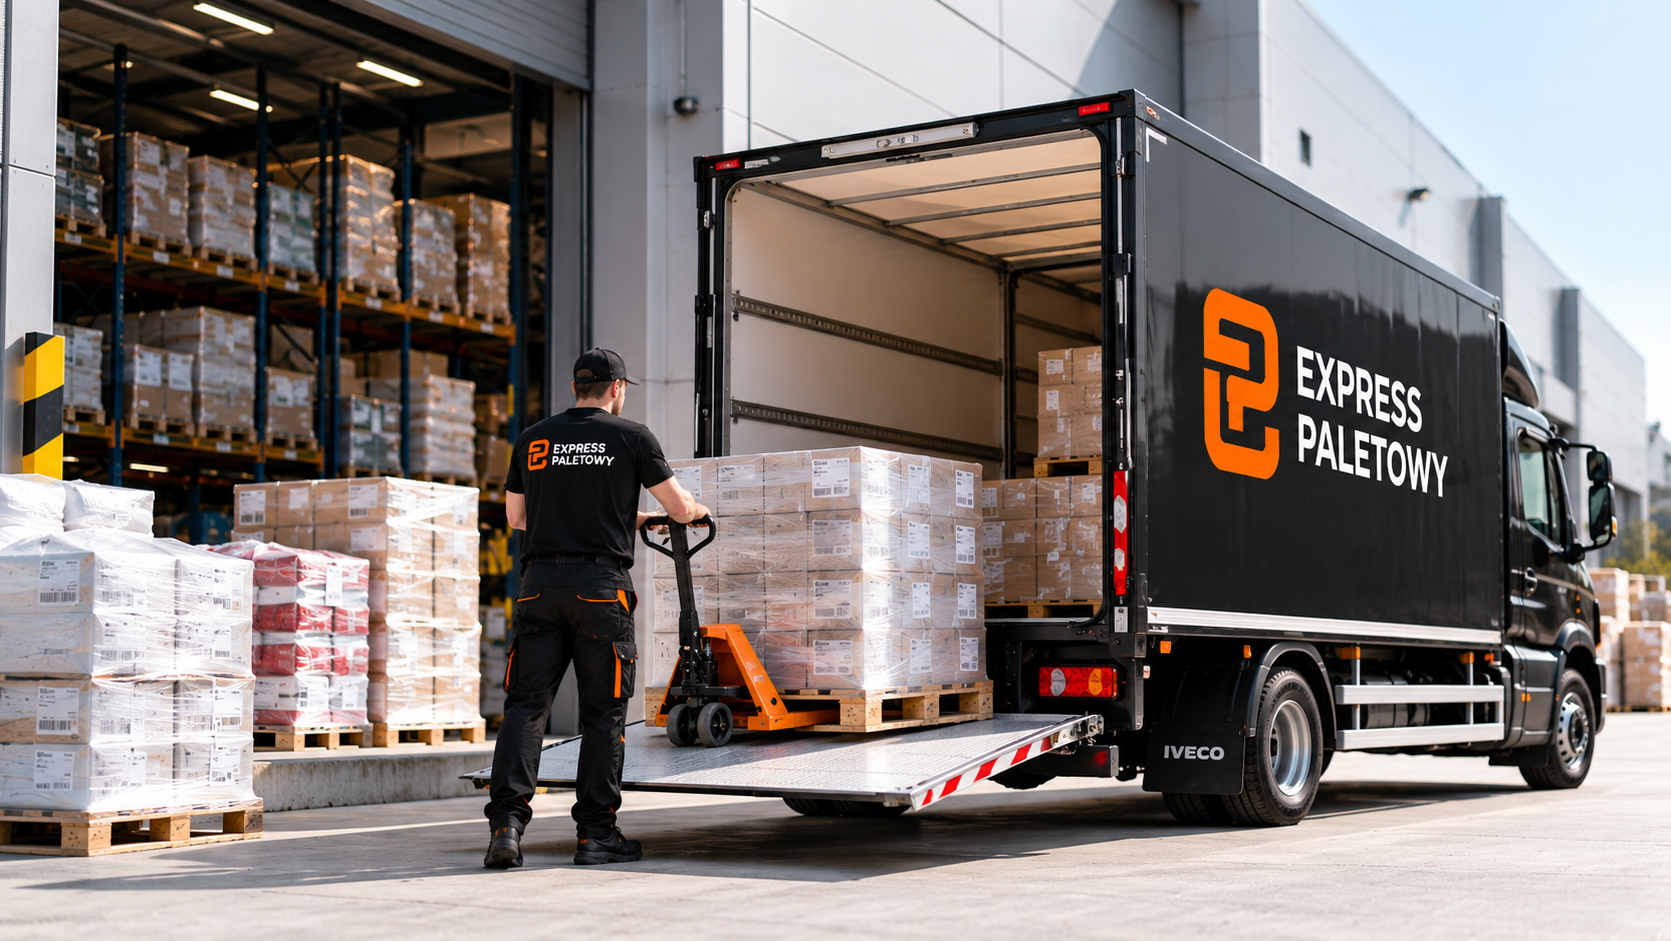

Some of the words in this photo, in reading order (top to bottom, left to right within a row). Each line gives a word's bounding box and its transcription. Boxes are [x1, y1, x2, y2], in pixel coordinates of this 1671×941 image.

[1296, 345, 1423, 433] EXPRESS
[553, 442, 606, 455] EXPRESS
[1297, 413, 1449, 498] PALETOWY
[551, 454, 615, 467] PALETOWY
[1163, 745, 1225, 761] IVECO
